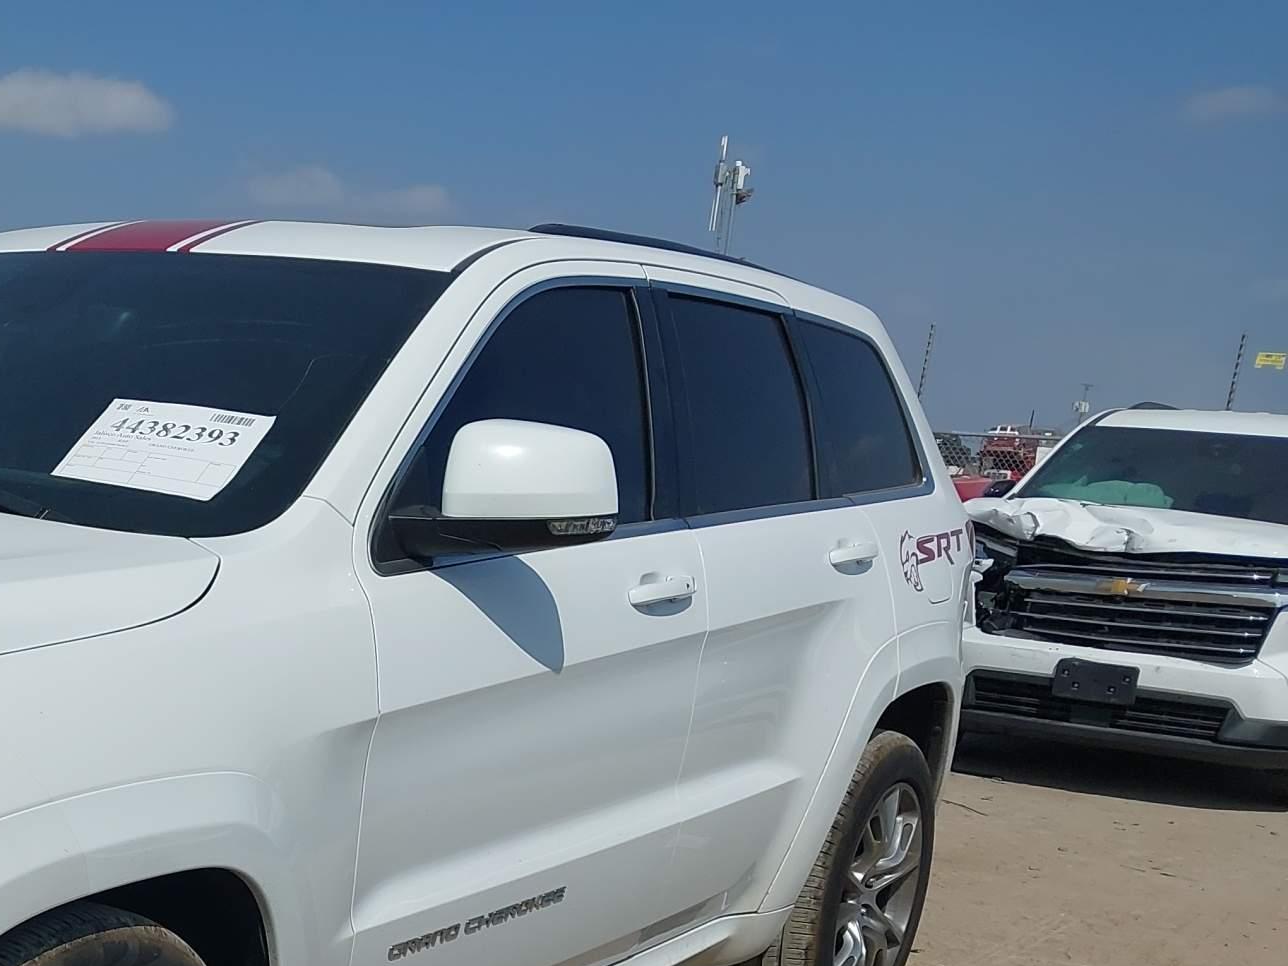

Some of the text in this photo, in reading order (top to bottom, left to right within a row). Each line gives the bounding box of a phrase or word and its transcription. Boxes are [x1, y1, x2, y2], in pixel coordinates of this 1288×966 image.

[111, 416, 240, 447] 44382393
[916, 528, 963, 565] SRT
[388, 886, 567, 962] GRAND CHEROKEE
